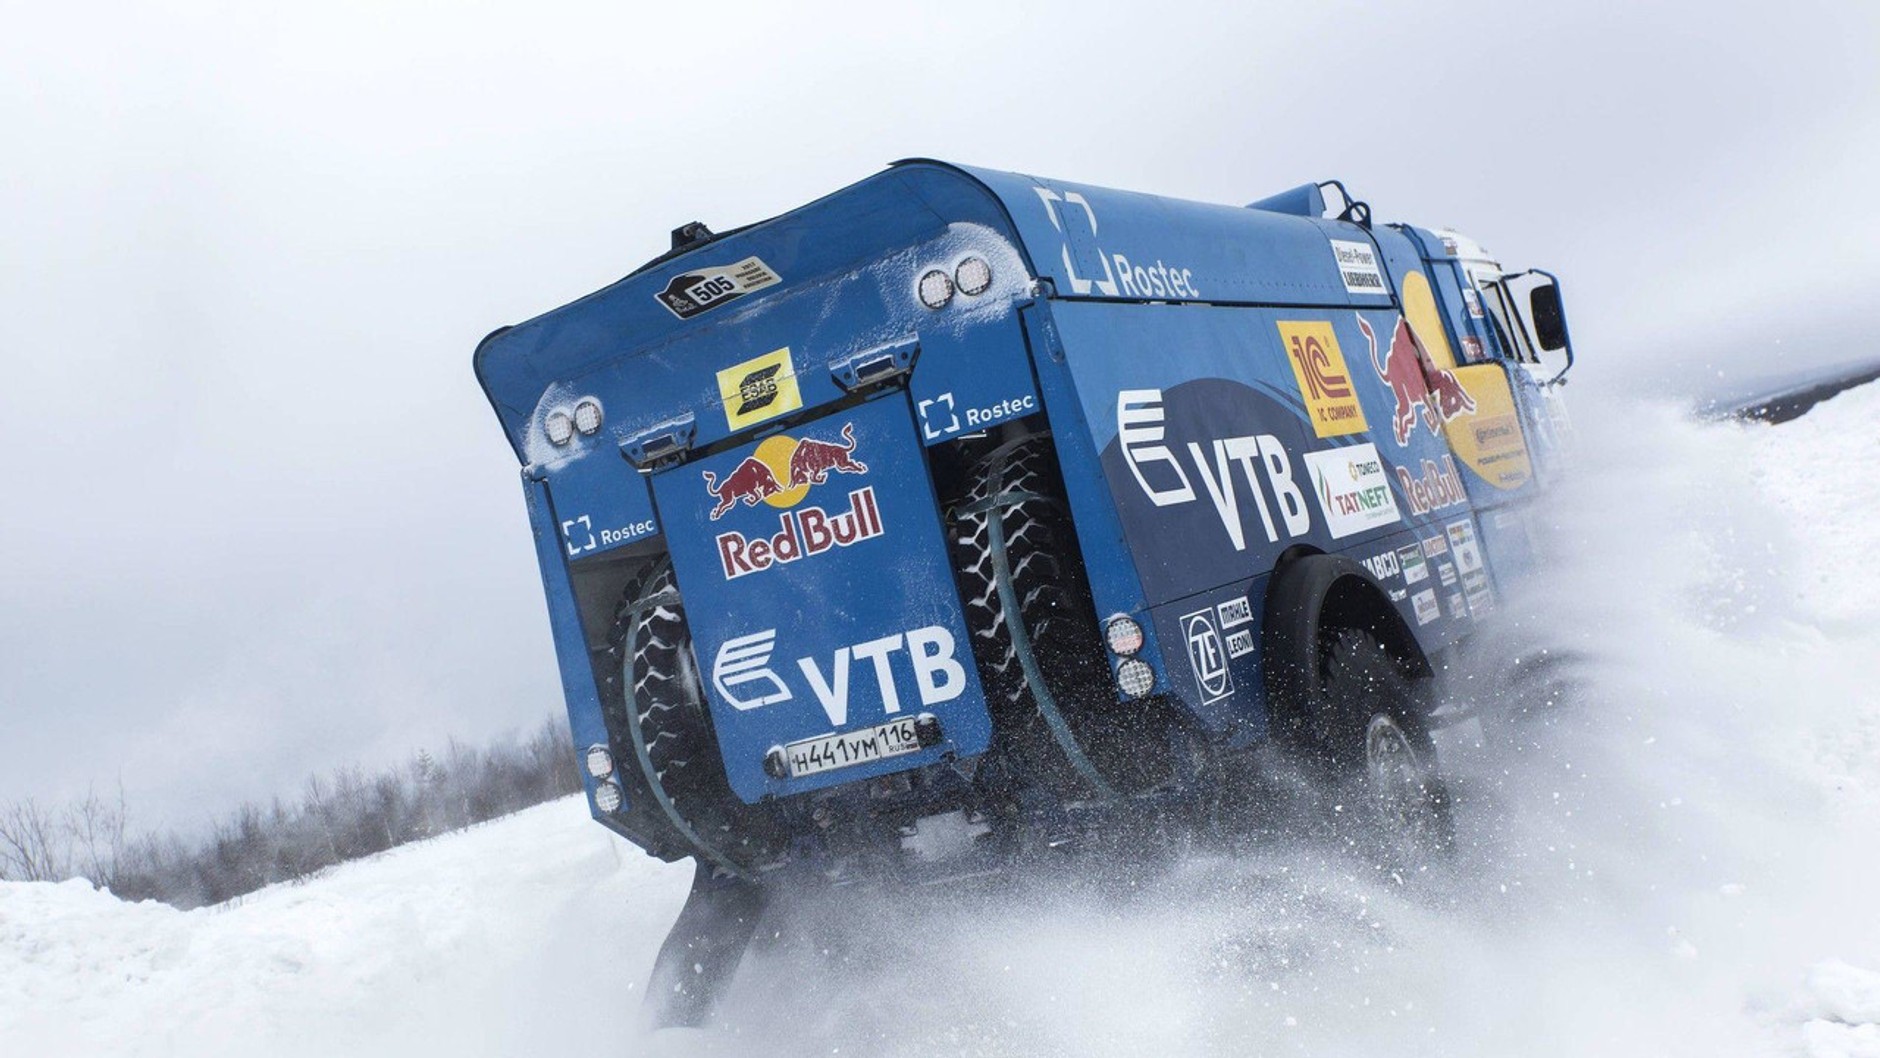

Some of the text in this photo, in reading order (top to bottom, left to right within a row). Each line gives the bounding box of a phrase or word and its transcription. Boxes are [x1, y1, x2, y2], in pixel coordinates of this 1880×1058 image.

[691, 276, 735, 301] 505
[1113, 254, 1199, 298] Rostec
[1342, 271, 1382, 288] LIEBHERR
[740, 377, 777, 402] ESAB
[966, 395, 1034, 426] Rostec
[1327, 405, 1357, 421] COMPANY
[1187, 434, 1310, 551] VTB
[1396, 454, 1467, 515] Red Bull
[1335, 485, 1390, 516] TATNEFT
[600, 520, 655, 545] Rostec
[716, 487, 884, 579] Red Bull
[1220, 600, 1251, 627] MAHLE
[1189, 629, 1226, 681] ZF
[1226, 632, 1254, 656] LEONI
[797, 626, 966, 726] VTB
[878, 723, 912, 746] 116
